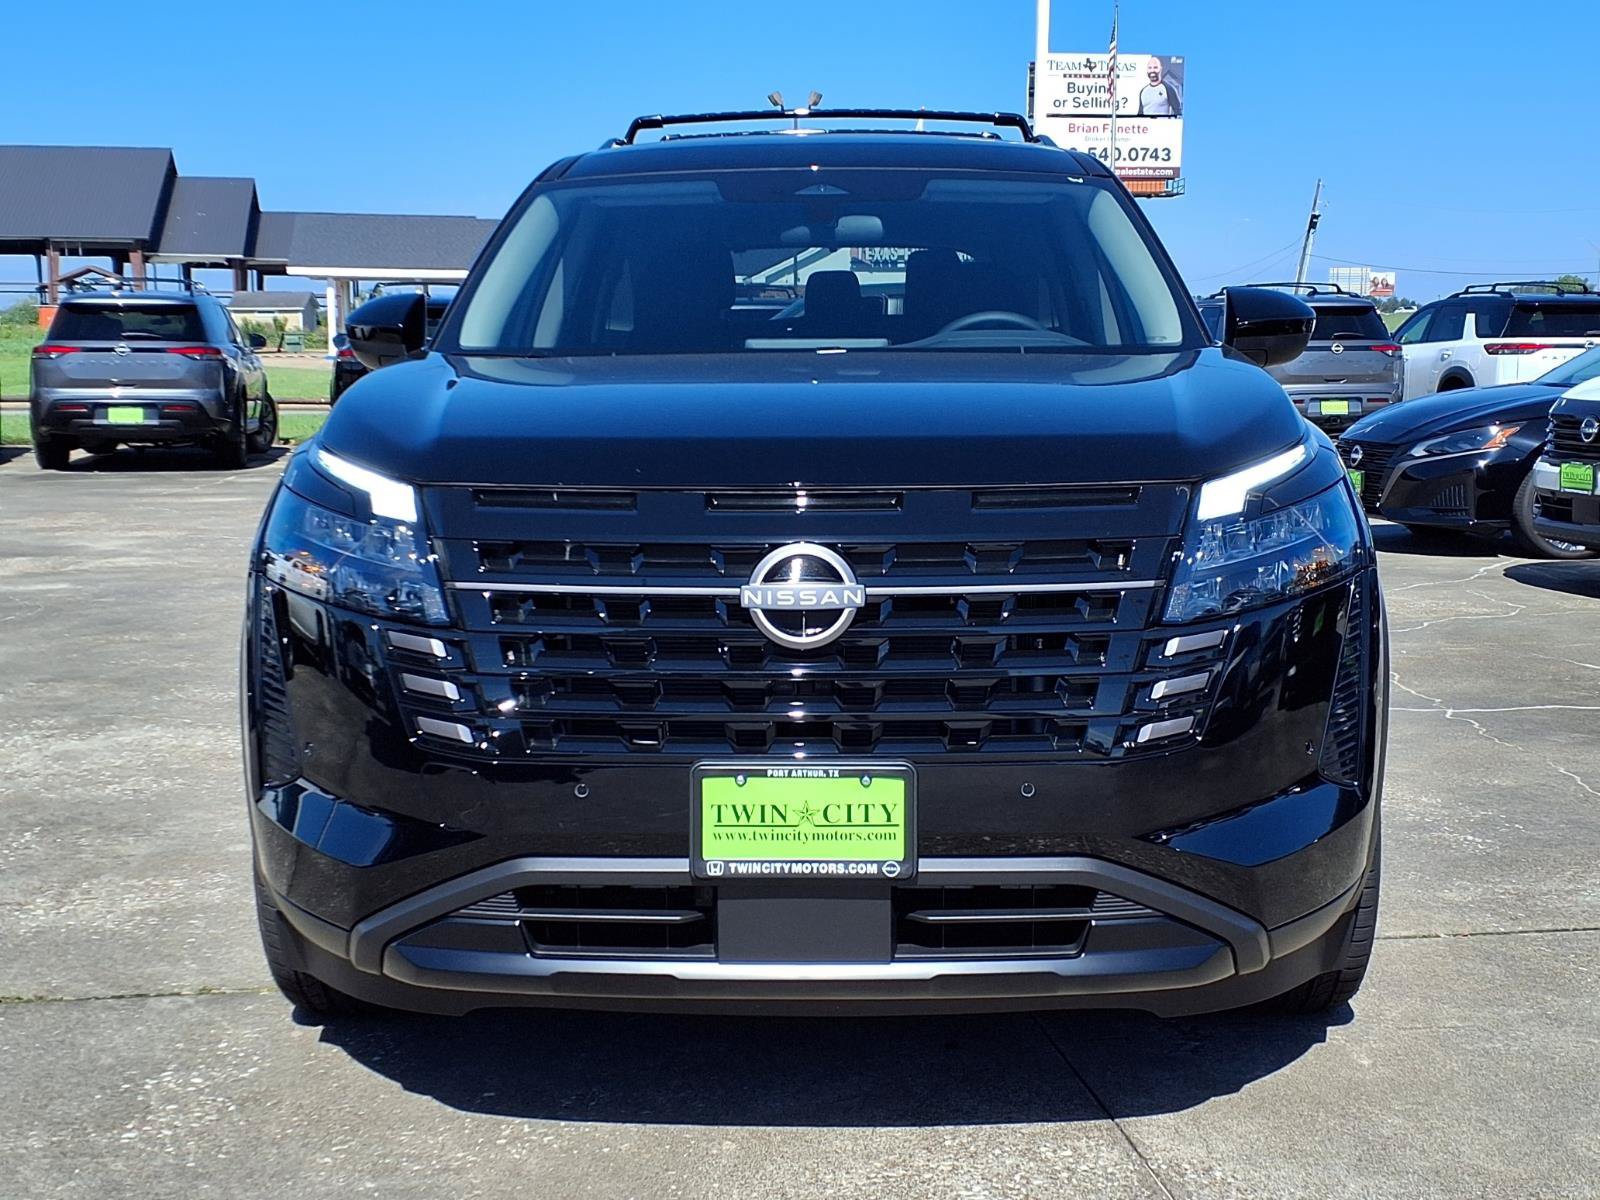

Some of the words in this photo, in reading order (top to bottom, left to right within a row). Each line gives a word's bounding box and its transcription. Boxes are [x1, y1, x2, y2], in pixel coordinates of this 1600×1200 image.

[1047, 60, 1083, 71] TEAM
[1067, 82, 1111, 97] Buyin
[1053, 99, 1068, 108] or
[1068, 123, 1099, 133] Brian
[1103, 123, 1149, 134] Fnette
[744, 590, 862, 605] NISSAN
[767, 769, 789, 778] PORT
[829, 769, 840, 778] TX
[711, 803, 788, 824] TWIN
[822, 803, 898, 824] CITY
[713, 829, 898, 845] www.twincitymotors.com
[729, 862, 878, 875] TWINCITYMOTORS.COM
